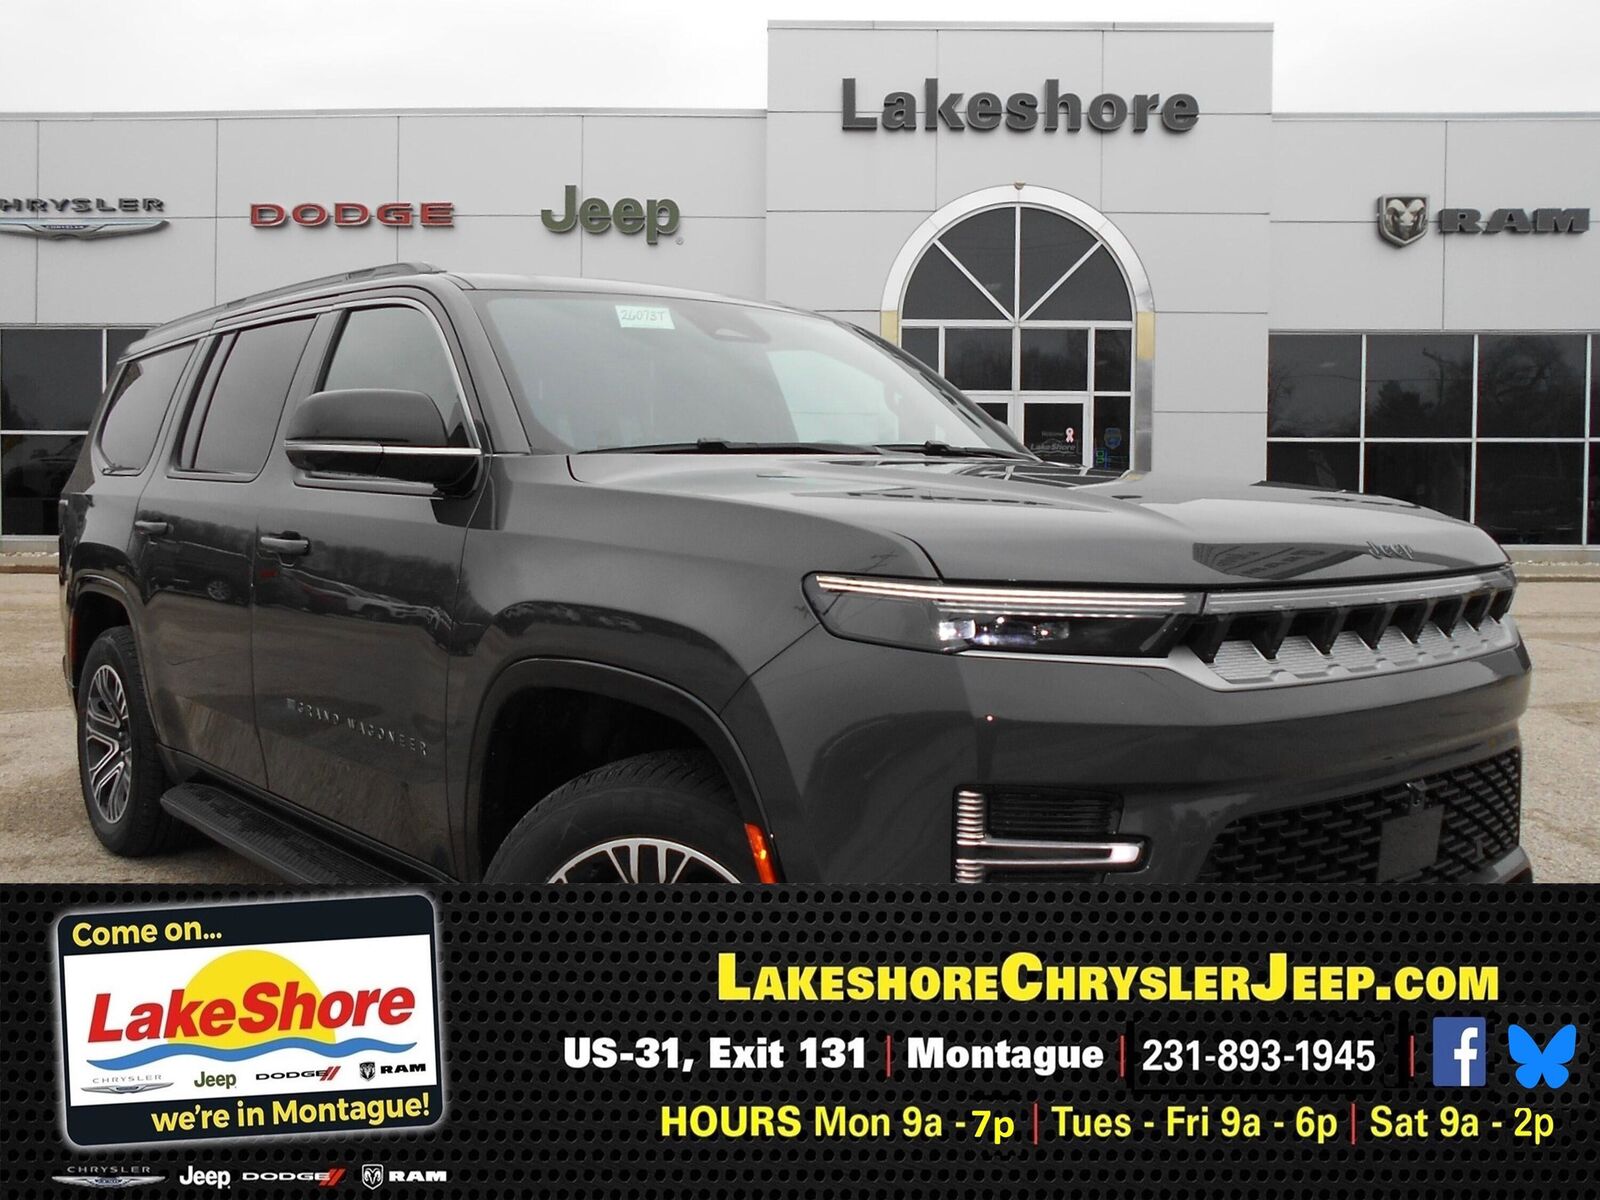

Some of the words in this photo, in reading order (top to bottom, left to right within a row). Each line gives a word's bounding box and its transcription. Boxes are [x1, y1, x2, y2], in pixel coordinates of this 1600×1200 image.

[841, 78, 1200, 135] Lakeshore
[0, 198, 165, 213] HRYSLER
[250, 202, 455, 228] DODGE
[541, 185, 680, 245] Jeep
[1439, 208, 1591, 234] RAM
[296, 702, 340, 725] GRAND
[346, 717, 428, 756] WAGONEER
